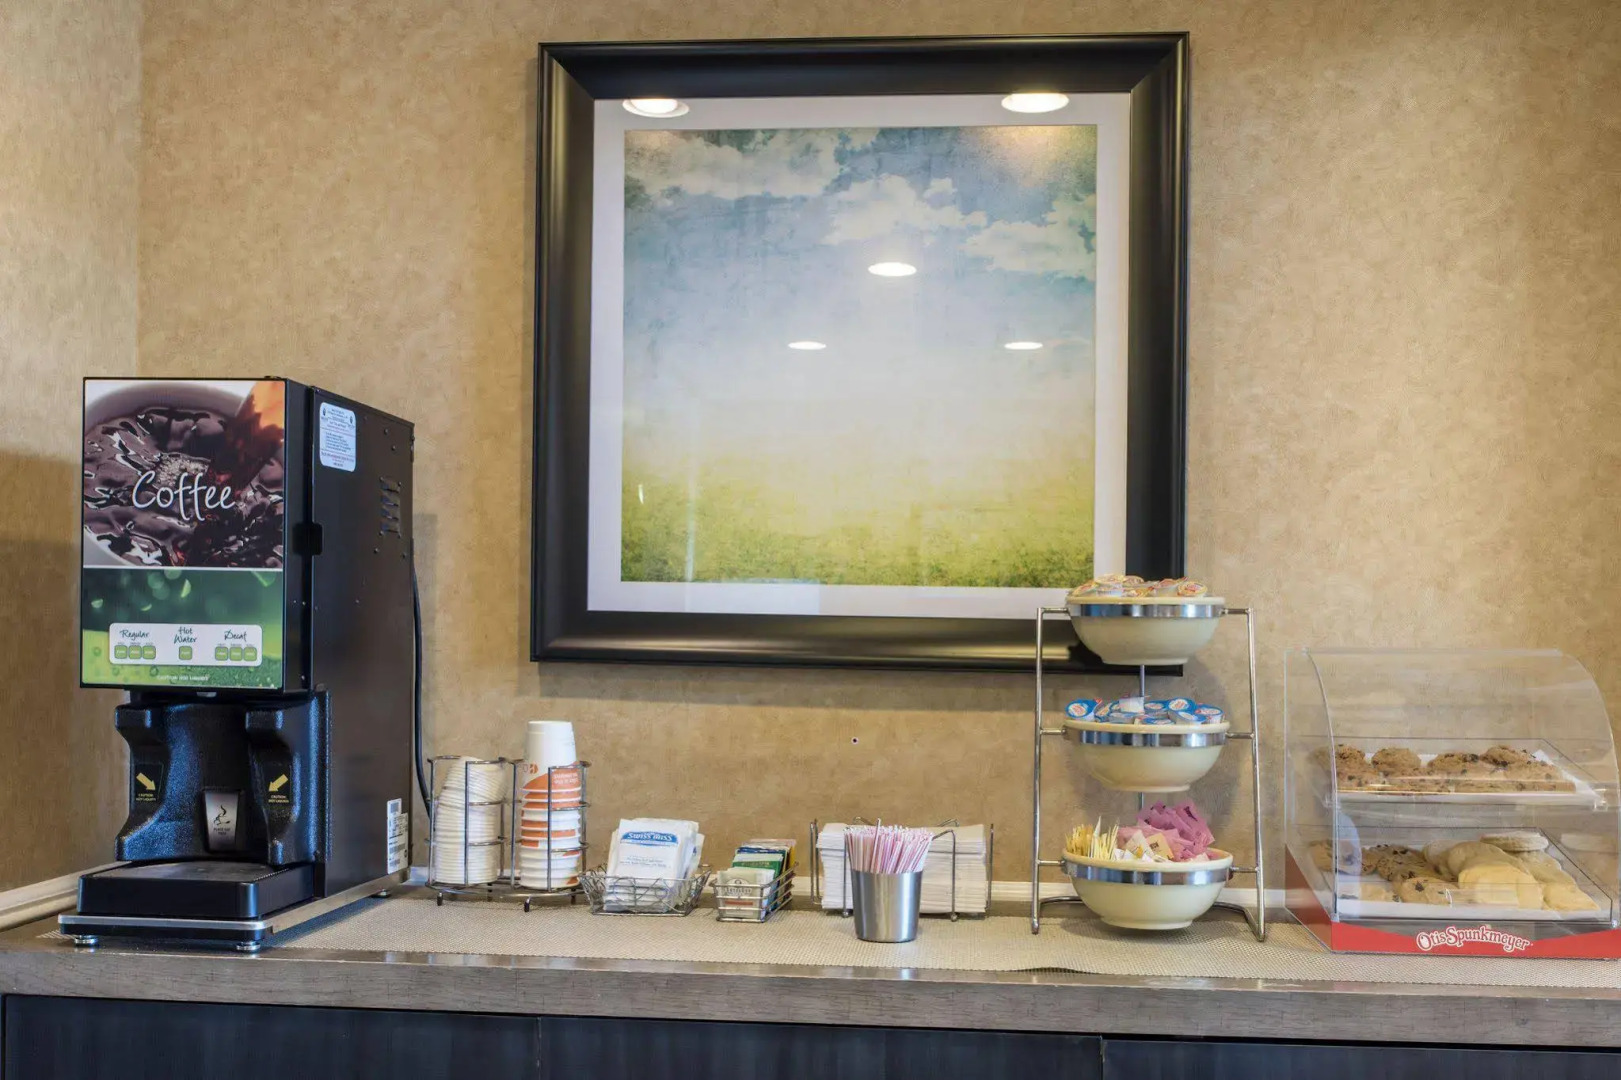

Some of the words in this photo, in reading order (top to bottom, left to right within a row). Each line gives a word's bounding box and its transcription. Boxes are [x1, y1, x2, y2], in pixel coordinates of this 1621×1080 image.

[132, 470, 236, 521] Coffee
[119, 630, 150, 641] Regular
[177, 626, 193, 635] Hot
[223, 629, 248, 642] Decaf
[173, 634, 198, 644] Water
[1416, 931, 1447, 951] Otis
[1447, 925, 1530, 952] Spunkmeyer
